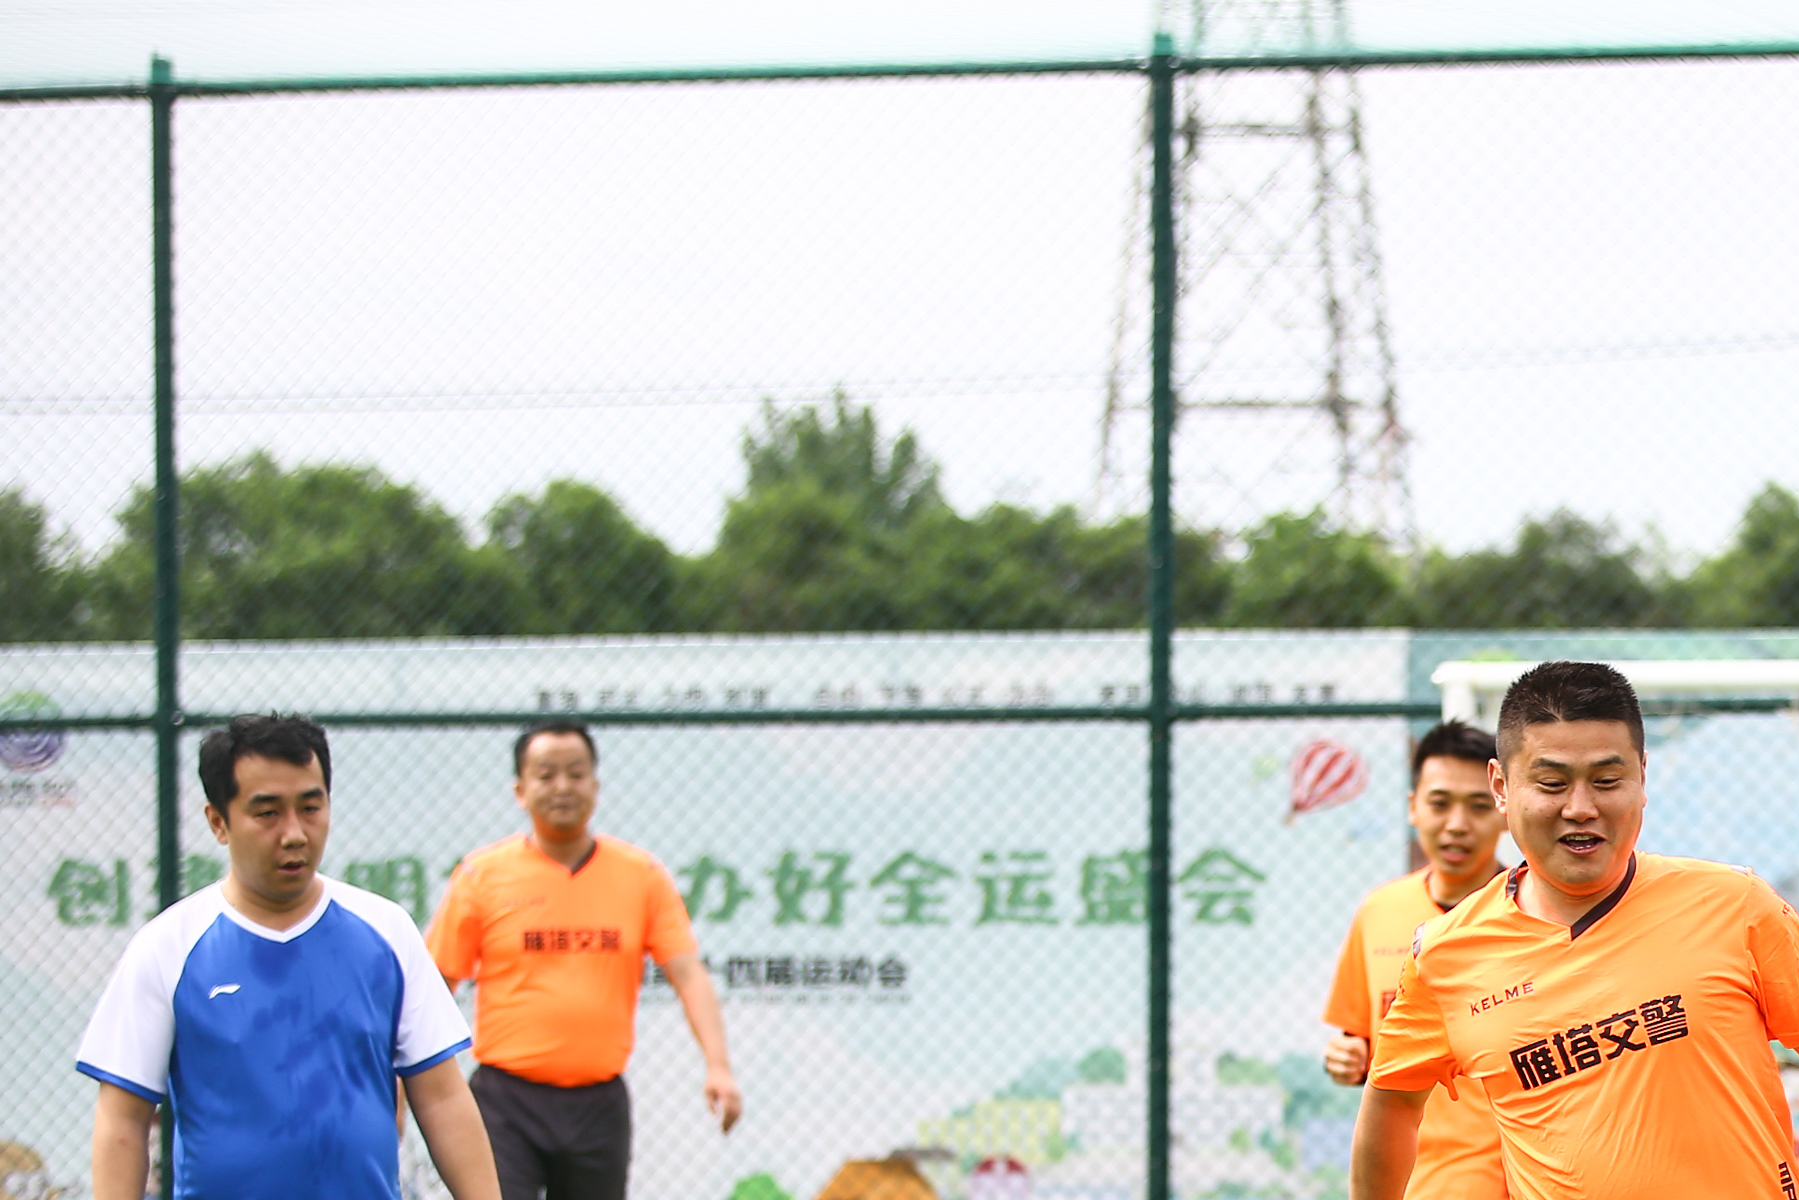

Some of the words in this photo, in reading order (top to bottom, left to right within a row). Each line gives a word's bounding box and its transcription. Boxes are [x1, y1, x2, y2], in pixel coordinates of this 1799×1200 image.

[1470, 982, 1534, 1016] KELME
[1509, 994, 1689, 1091] 雁塔交警
